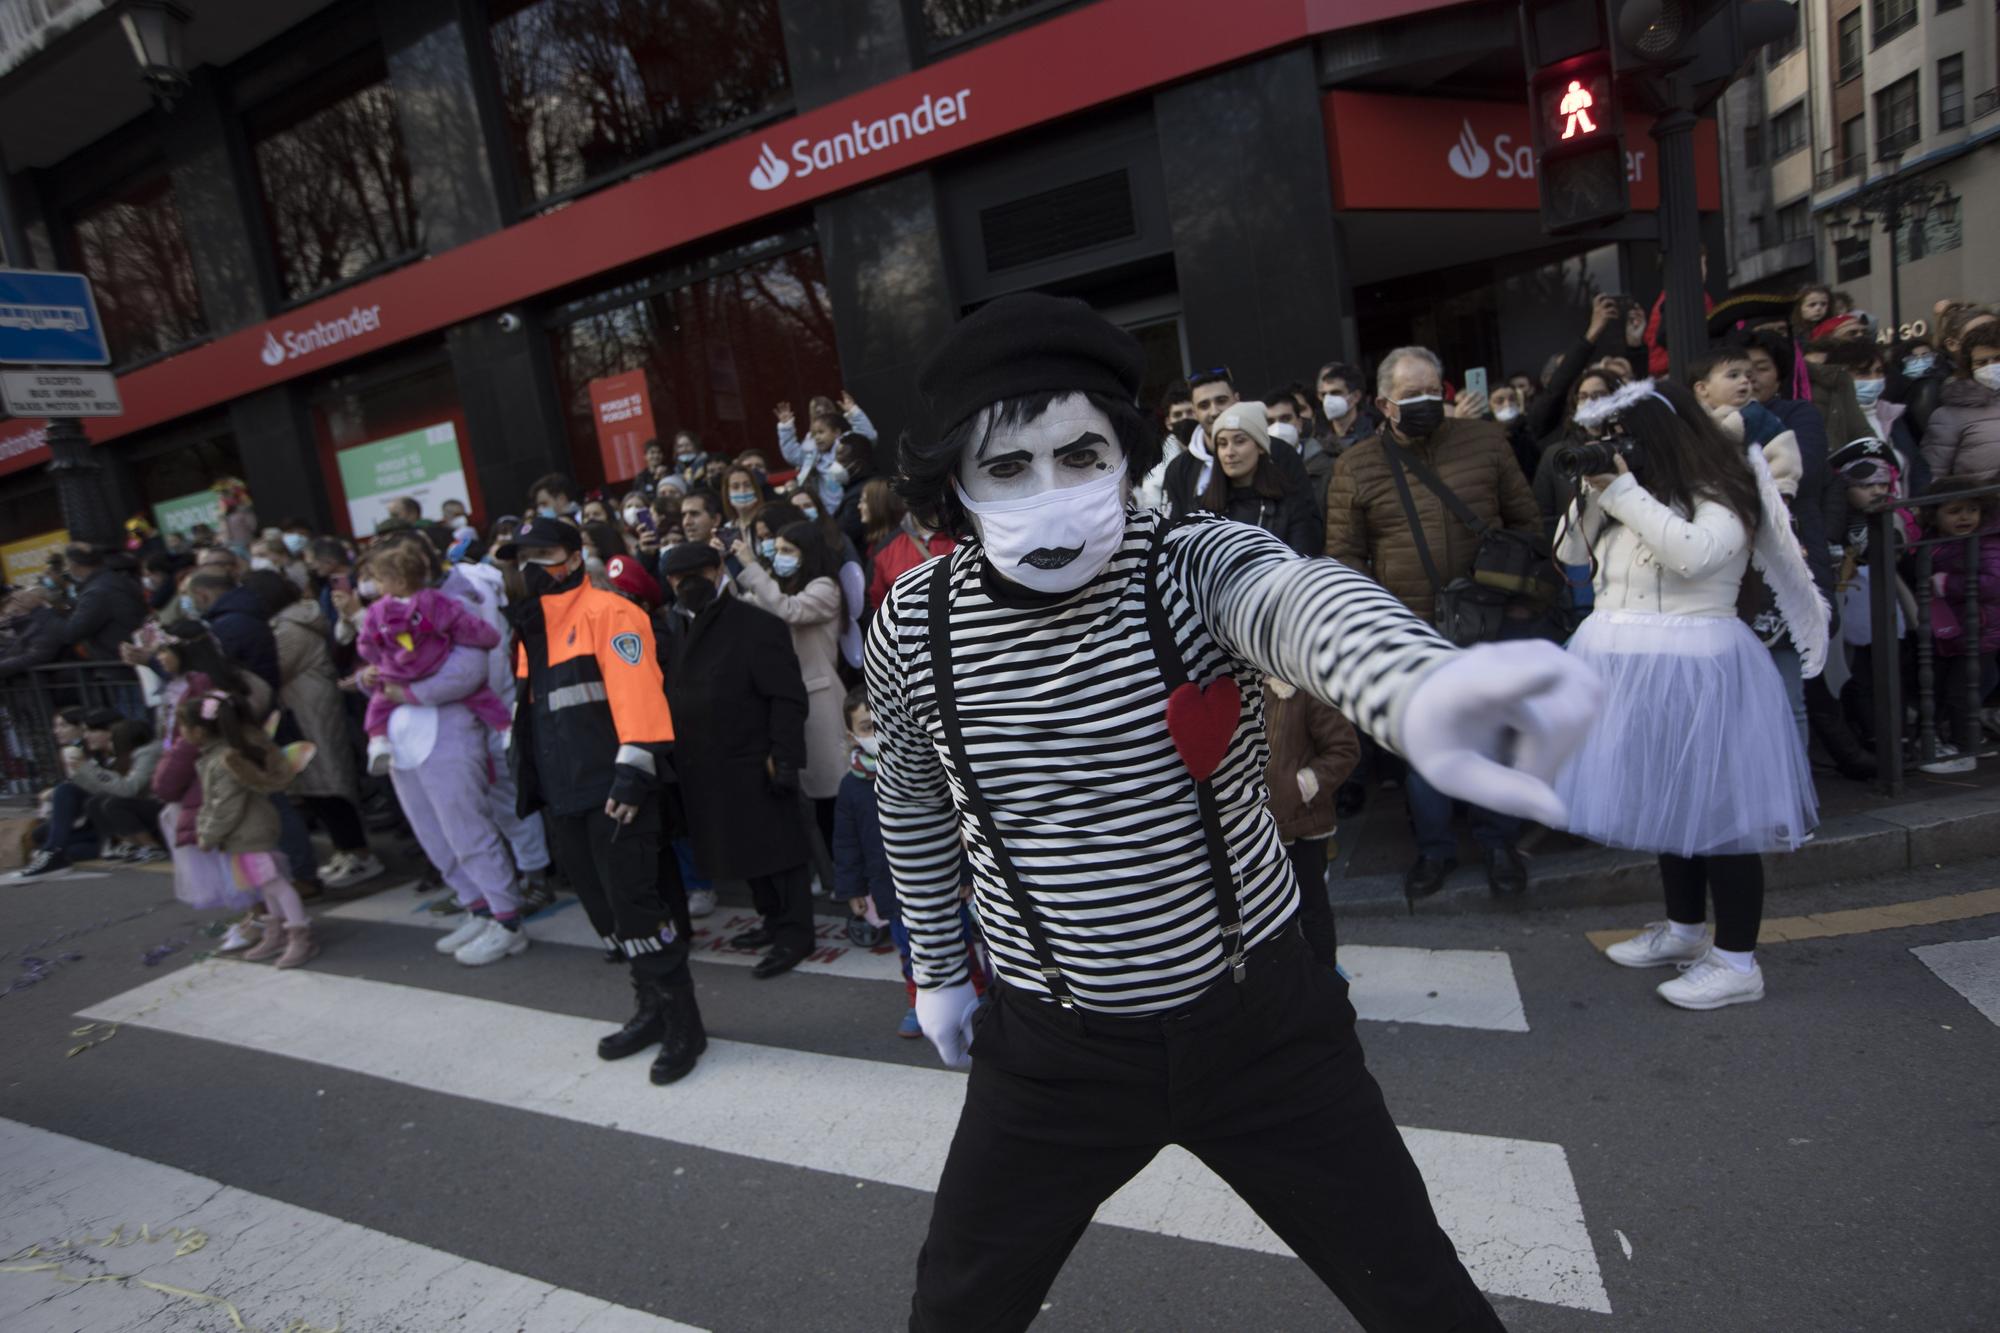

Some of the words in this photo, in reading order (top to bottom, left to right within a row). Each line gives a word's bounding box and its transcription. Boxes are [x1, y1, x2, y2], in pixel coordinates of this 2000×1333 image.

[791, 88, 970, 177] Santander
[283, 304, 381, 359] Santander
[29, 389, 51, 398] BUS
[55, 389, 96, 398] URBANO
[36, 376, 83, 386] EXCEPTO
